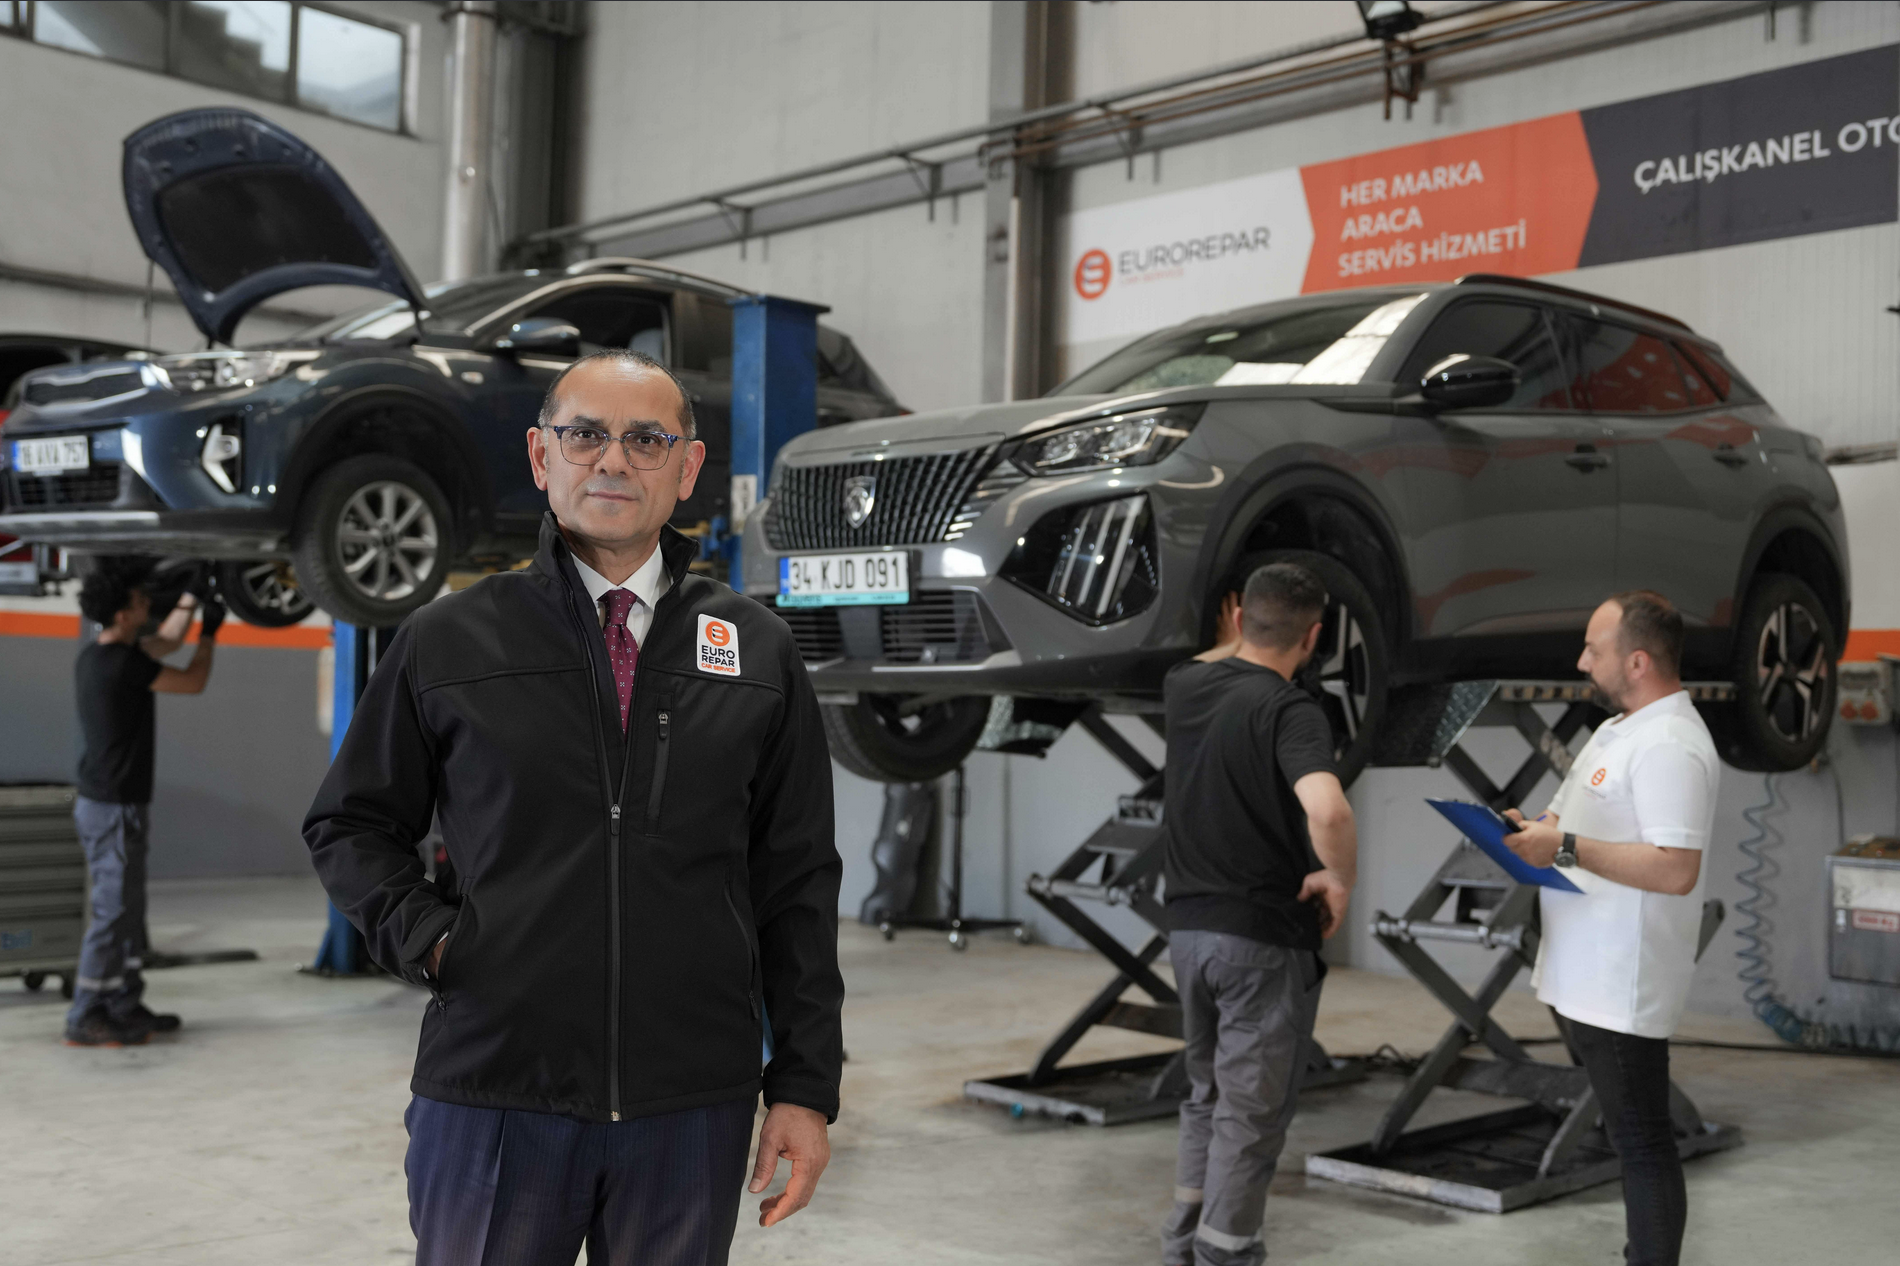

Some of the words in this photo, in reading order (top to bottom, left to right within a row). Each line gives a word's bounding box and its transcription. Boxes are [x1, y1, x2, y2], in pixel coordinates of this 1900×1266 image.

[1633, 130, 1831, 195] ÇALIŞKANEL
[1339, 182, 1388, 210] HER
[1392, 161, 1484, 198] MARKA
[1340, 206, 1424, 243] ARACA
[1118, 226, 1272, 275] EUROREPAR
[1338, 242, 1416, 278] SERVİS
[1421, 219, 1527, 263] HİZMETİ
[791, 562, 812, 590] 34
[821, 559, 855, 590] KJD
[865, 556, 900, 588] 091
[702, 645, 735, 659] EURO
[702, 655, 735, 667] REPAR
[713, 665, 736, 673] SERVICE
